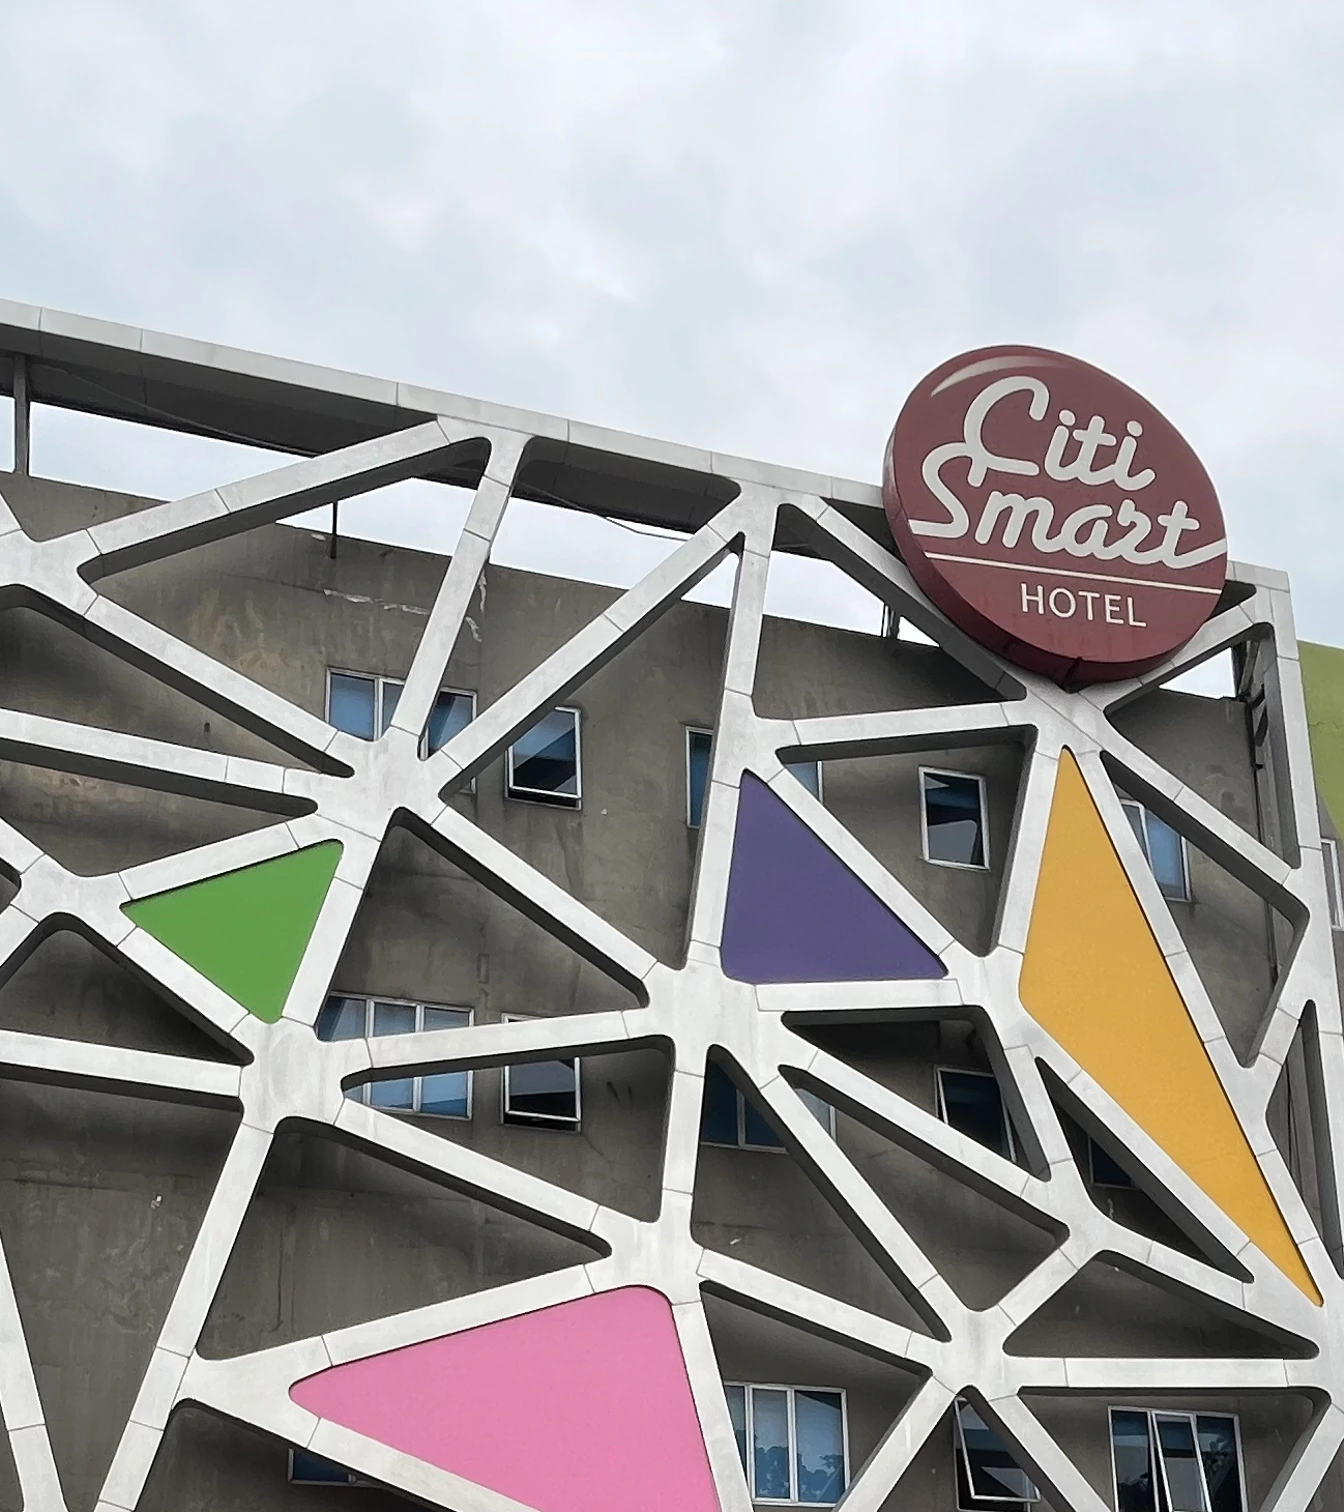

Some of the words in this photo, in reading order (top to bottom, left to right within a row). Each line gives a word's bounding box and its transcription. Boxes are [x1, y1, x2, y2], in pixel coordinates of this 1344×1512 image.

[963, 375, 1156, 491] Citi
[908, 442, 1228, 569] Smart
[1020, 583, 1147, 628] HOTEL
